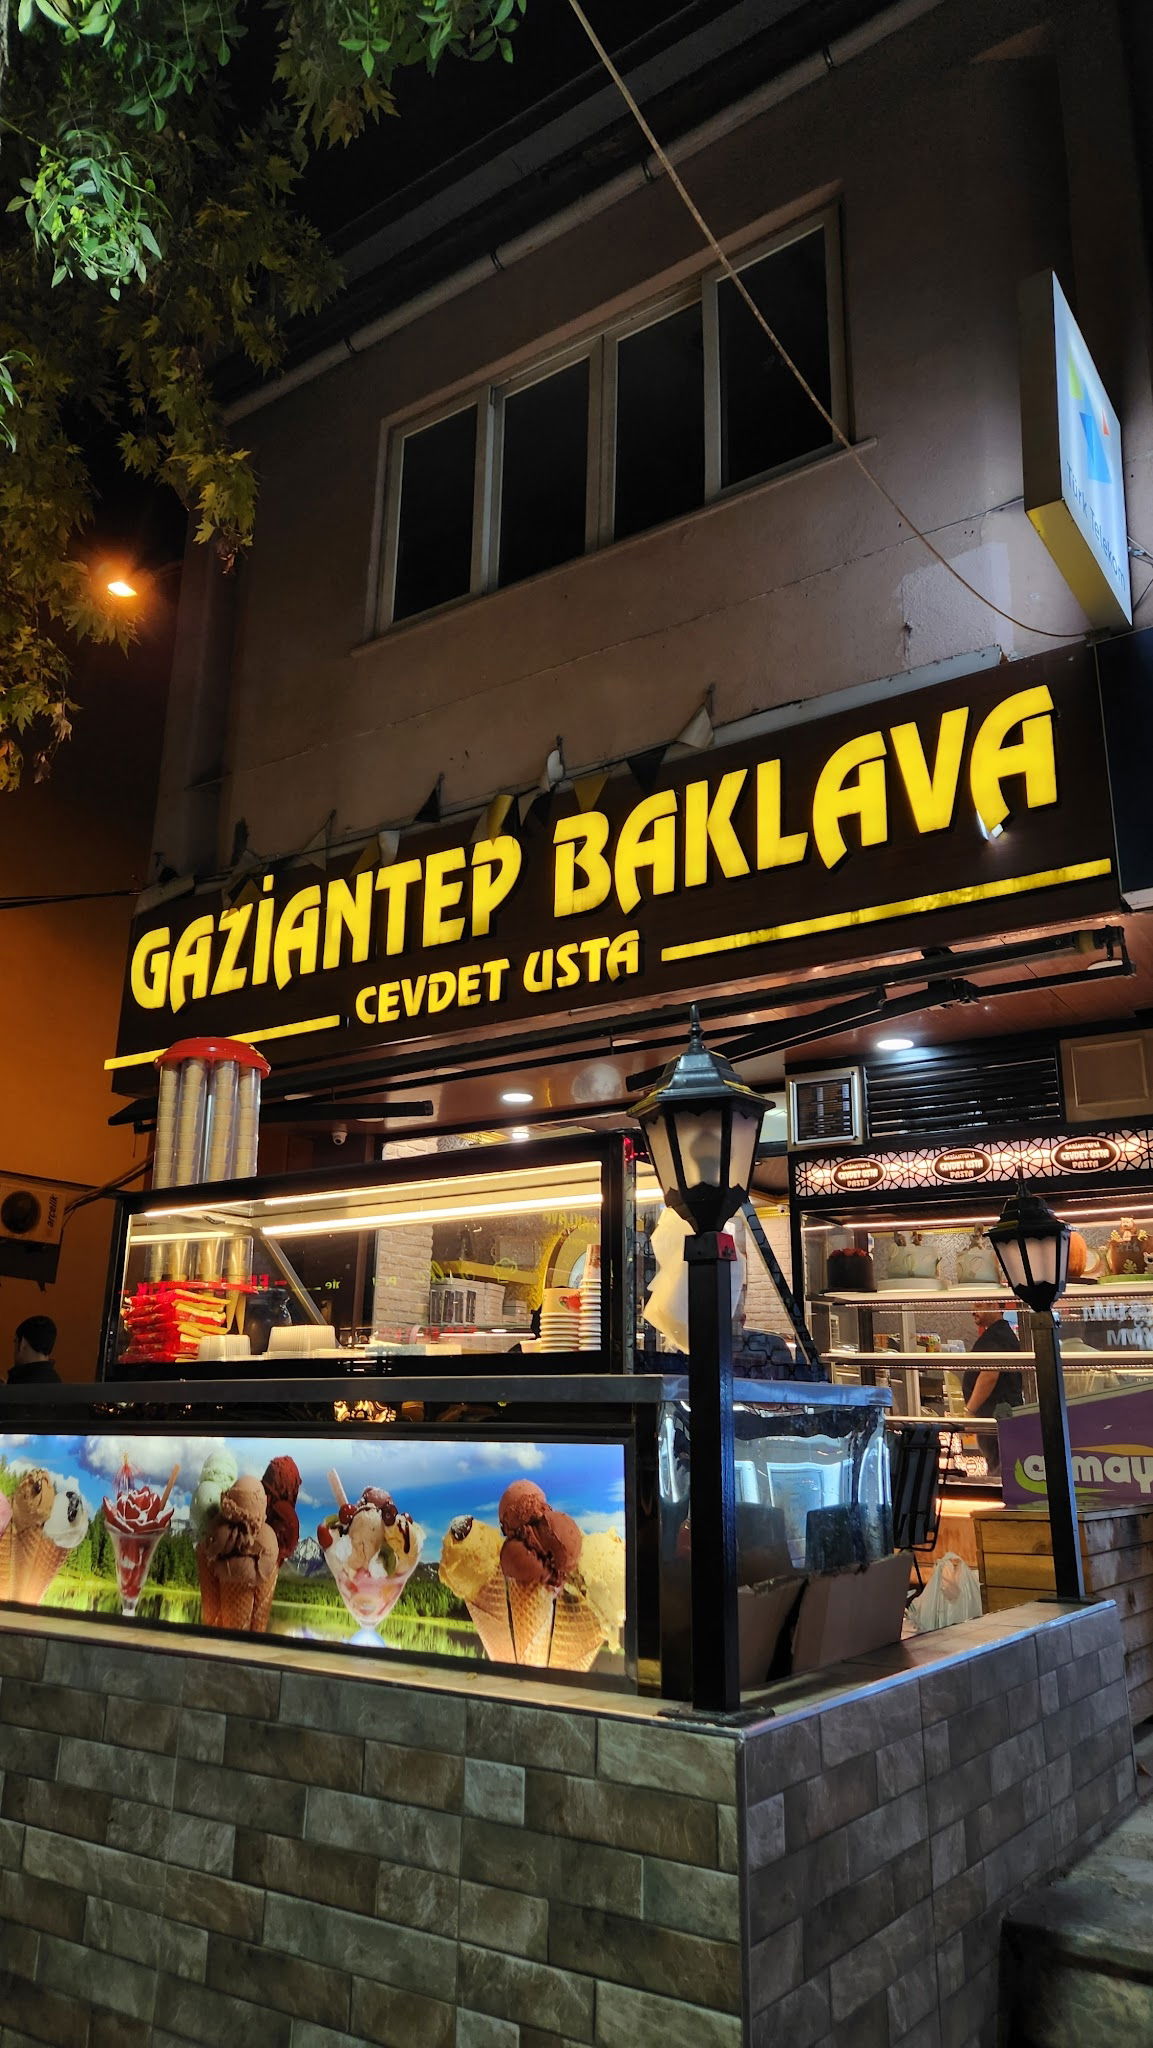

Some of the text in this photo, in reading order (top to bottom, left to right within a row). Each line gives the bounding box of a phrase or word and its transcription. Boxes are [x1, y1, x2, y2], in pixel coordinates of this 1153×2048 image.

[1066, 460, 1126, 592] Türk Telekom
[552, 684, 1058, 918] BAKLAVA
[354, 929, 641, 1024] CEVDET USTA
[1061, 1149, 1088, 1160] CEVDET
[940, 1161, 965, 1171] CEVDET
[1072, 1160, 1099, 1168] PASTA
[950, 1170, 974, 1178] PASTA
[847, 1179, 869, 1187] PASTA
